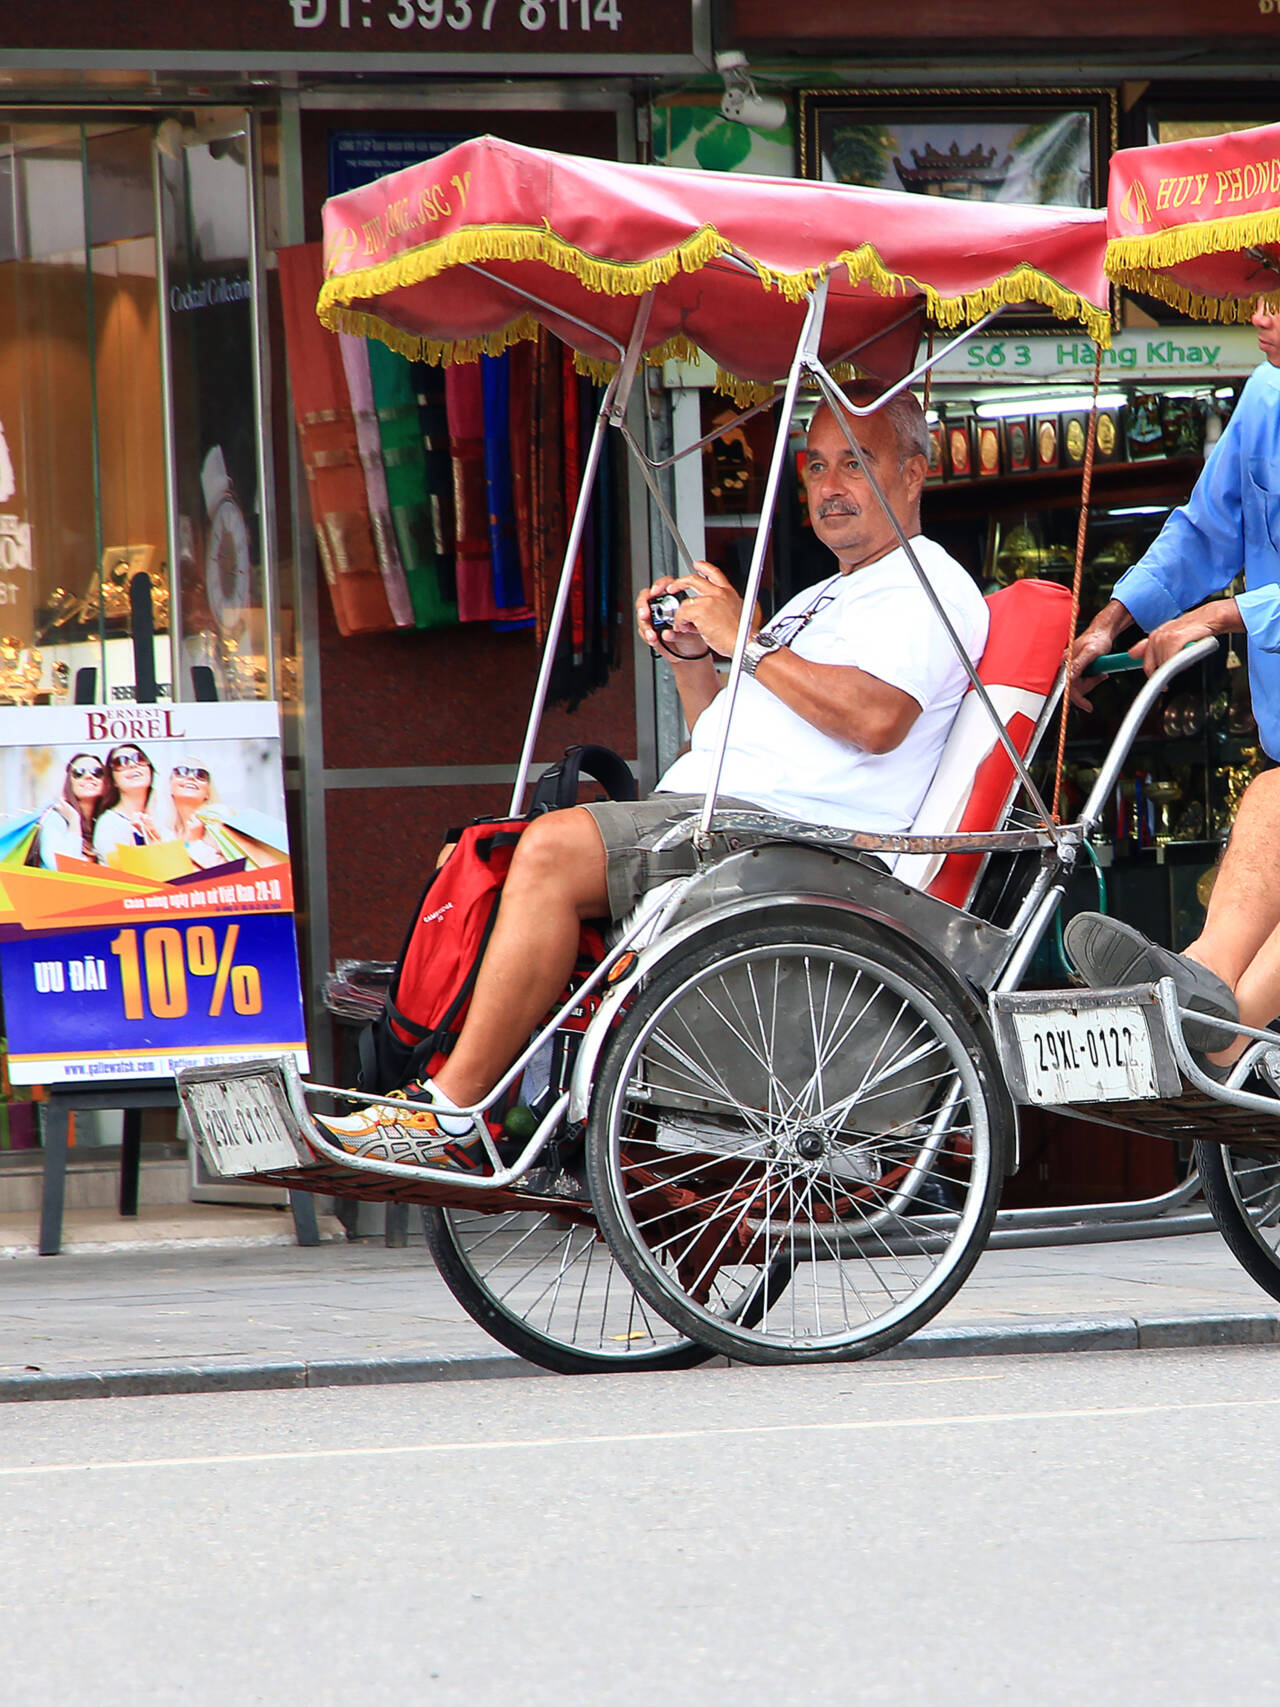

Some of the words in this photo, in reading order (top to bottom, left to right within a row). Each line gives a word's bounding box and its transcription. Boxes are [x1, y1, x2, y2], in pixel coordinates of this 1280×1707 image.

[1156, 172, 1209, 211] HUY
[967, 341, 1006, 368] Số
[1014, 345, 1032, 366] 3
[1056, 342, 1137, 369] Hàng
[1146, 341, 1222, 367] Khay
[85, 710, 186, 740] BOREL
[106, 709, 161, 719] ERNEST
[34, 960, 65, 993] ƯU
[110, 924, 263, 1020] 10%
